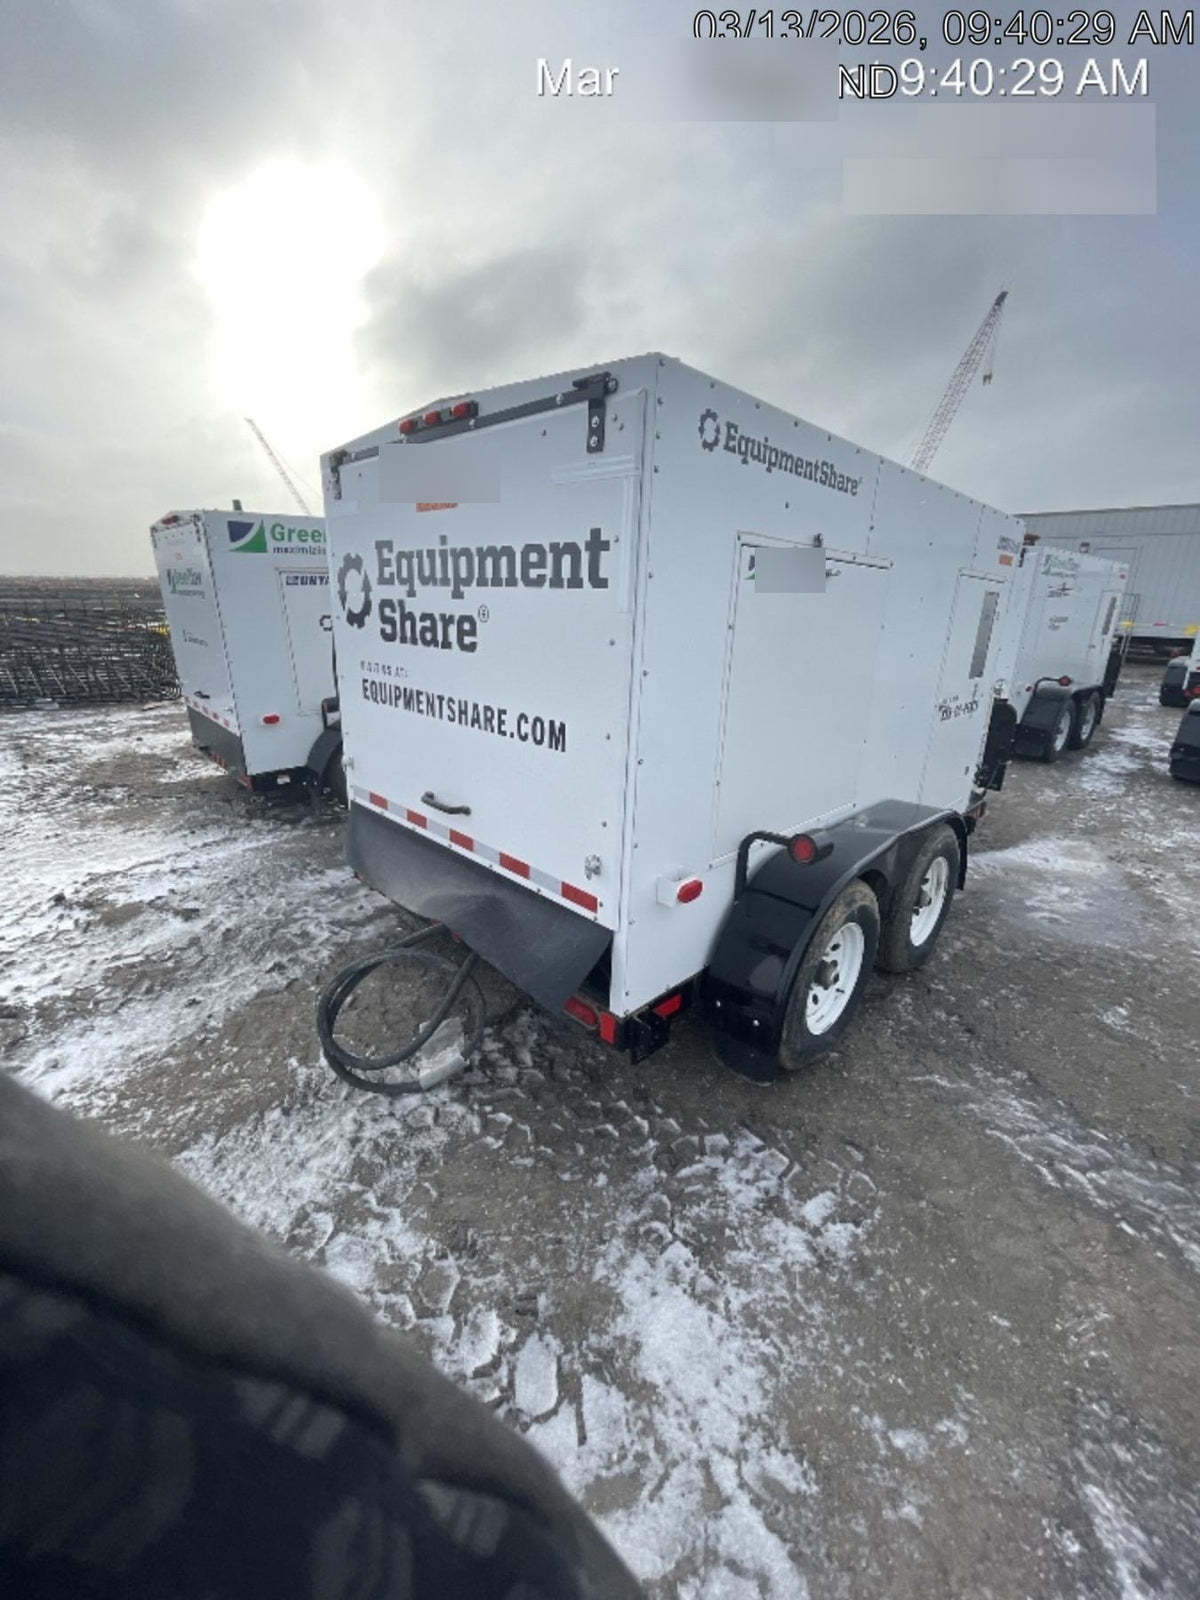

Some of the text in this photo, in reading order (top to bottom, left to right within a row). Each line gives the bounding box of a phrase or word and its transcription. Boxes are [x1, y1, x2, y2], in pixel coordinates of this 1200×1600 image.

[723, 421, 859, 497] EquipmentShare
[375, 527, 611, 600] Equipment
[361, 678, 567, 753] EQUIPMENTSHARE.COM
